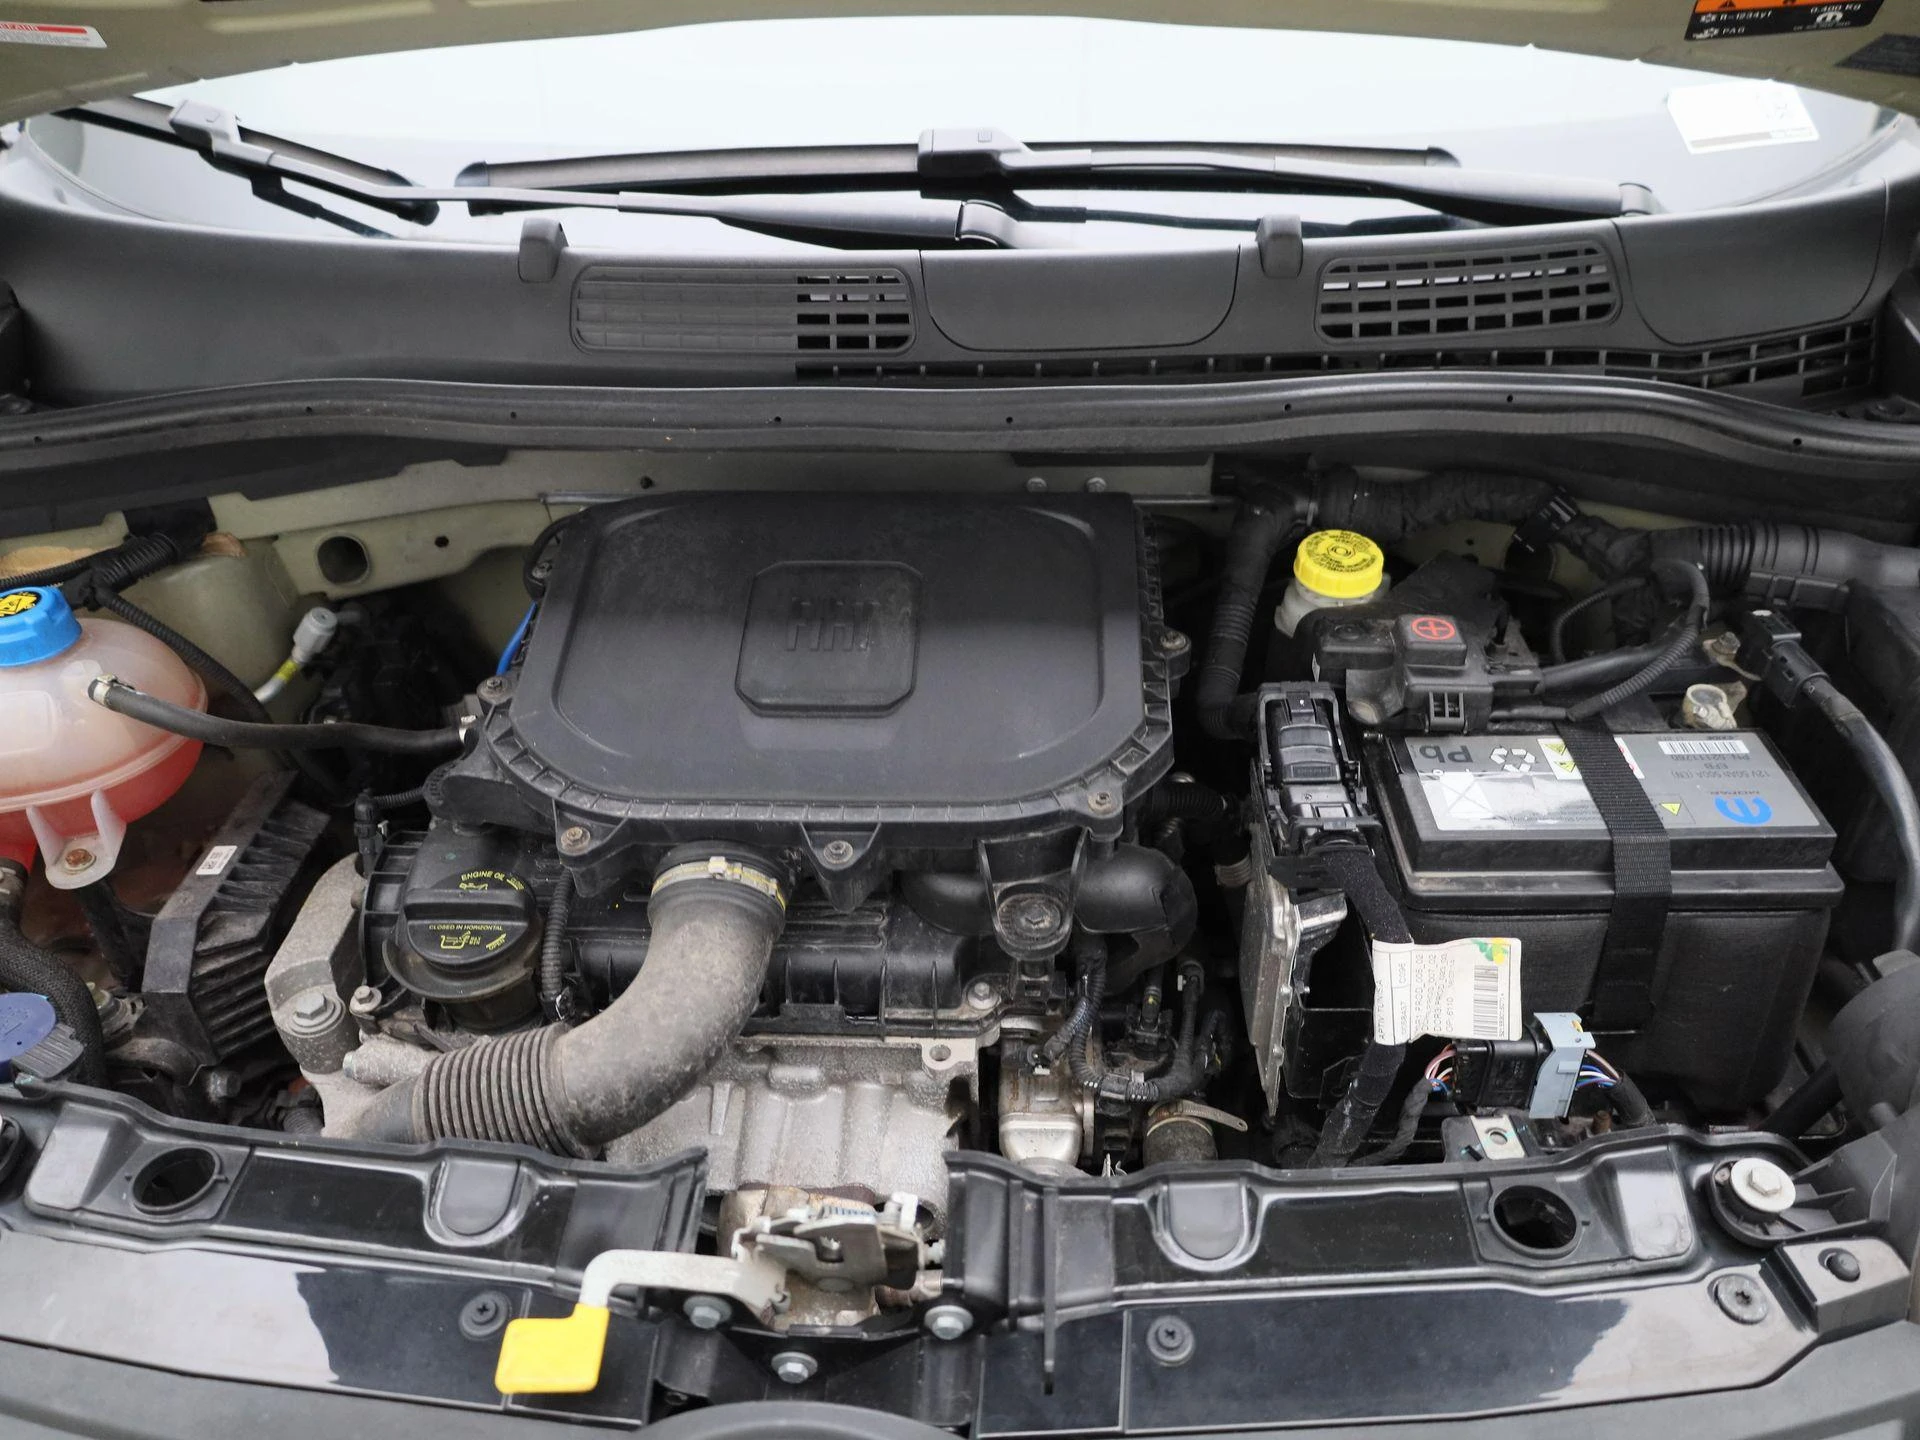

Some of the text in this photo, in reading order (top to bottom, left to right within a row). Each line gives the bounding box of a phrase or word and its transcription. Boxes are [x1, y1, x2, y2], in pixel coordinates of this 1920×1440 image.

[785, 596, 881, 652] FIAT
[1419, 744, 1473, 763] Pb
[461, 870, 505, 882] ENGINE OIL
